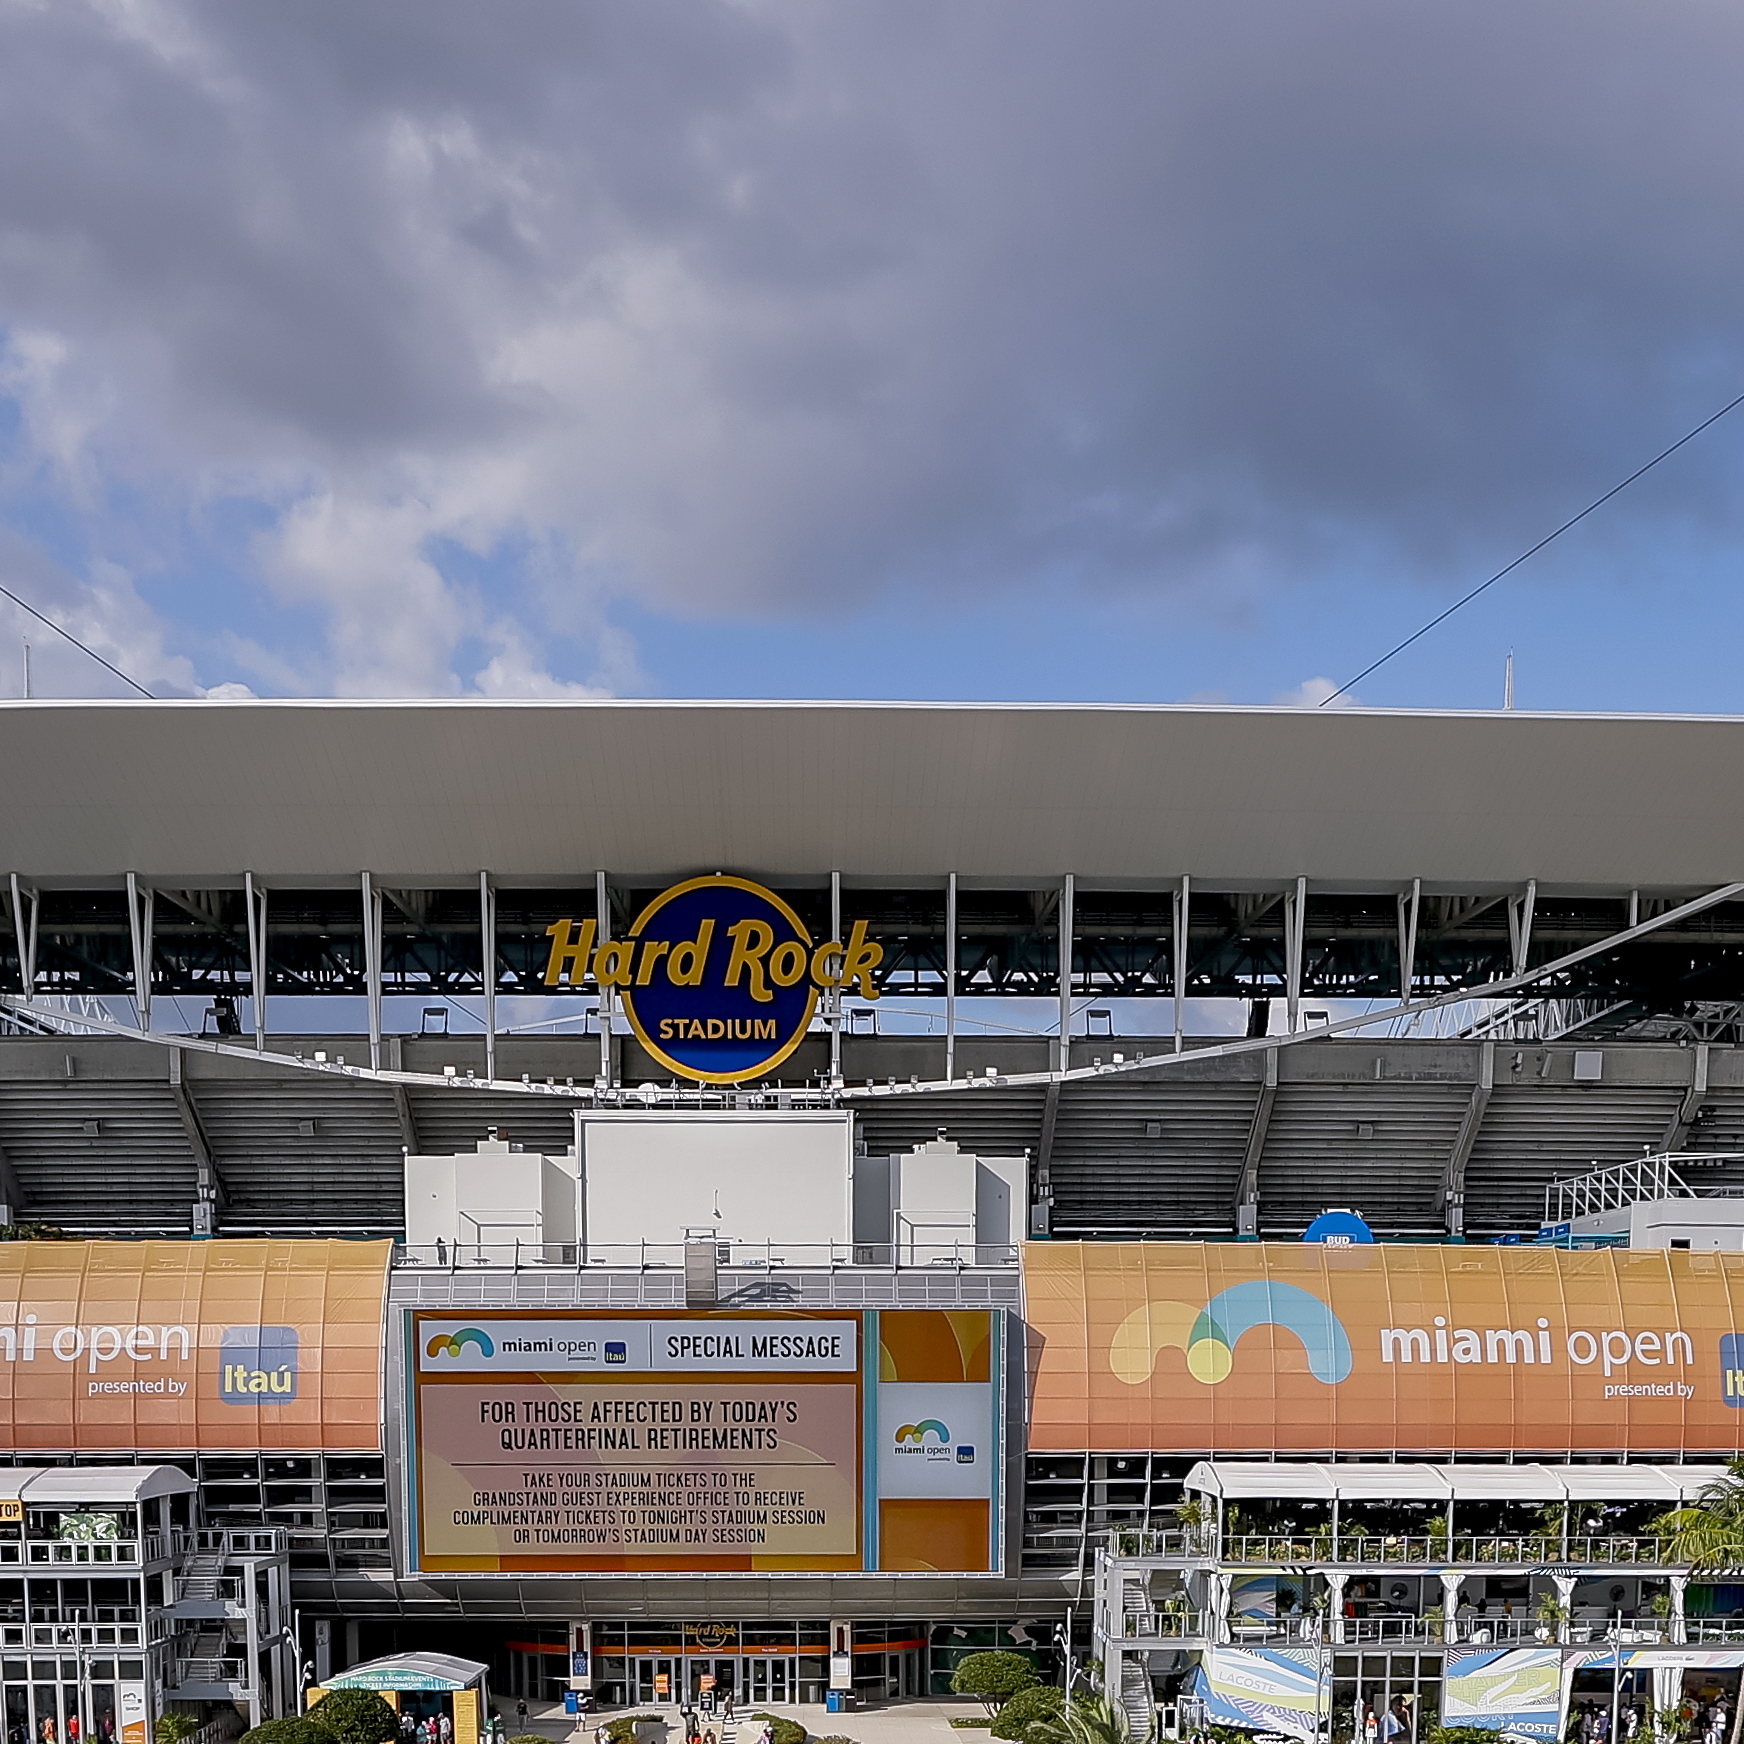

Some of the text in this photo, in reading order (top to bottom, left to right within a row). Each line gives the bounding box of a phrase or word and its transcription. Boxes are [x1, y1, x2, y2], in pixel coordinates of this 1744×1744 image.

[544, 918, 884, 1002] Hard Rock
[659, 1018, 776, 1039] STADIUM
[52, 1325, 189, 1372] open
[502, 1338, 596, 1355] miami open
[667, 1336, 841, 1358] SPECIAL MESSAGE
[1380, 1316, 1694, 1376] miami open
[88, 1378, 187, 1397] presented by
[224, 1364, 293, 1394] Itaú
[1604, 1380, 1695, 1401] presented by
[481, 1402, 798, 1423] FOR THOSE AFFECTED BY TODAY'S
[501, 1428, 778, 1450] QUARTERFINAL RETIREMENTS
[894, 1445, 950, 1456] miami open
[522, 1473, 755, 1488] TAKE YOUR STADIUM TICKETS TO THE
[473, 1491, 805, 1506] GRANDSTAND GUEST EXPERIENCE OFFICE TO RECEIVE
[453, 1510, 826, 1525] COMPLIMENTARY TICKETS TO TONIGHT'S STADIUM SESSION
[513, 1528, 766, 1544] OR TOMORROW'S STADIUM DAY SESSION
[711, 1624, 736, 1637] Rock
[1219, 1671, 1277, 1694] LACOSTE
[1500, 1721, 1557, 1734] LACOSTE
